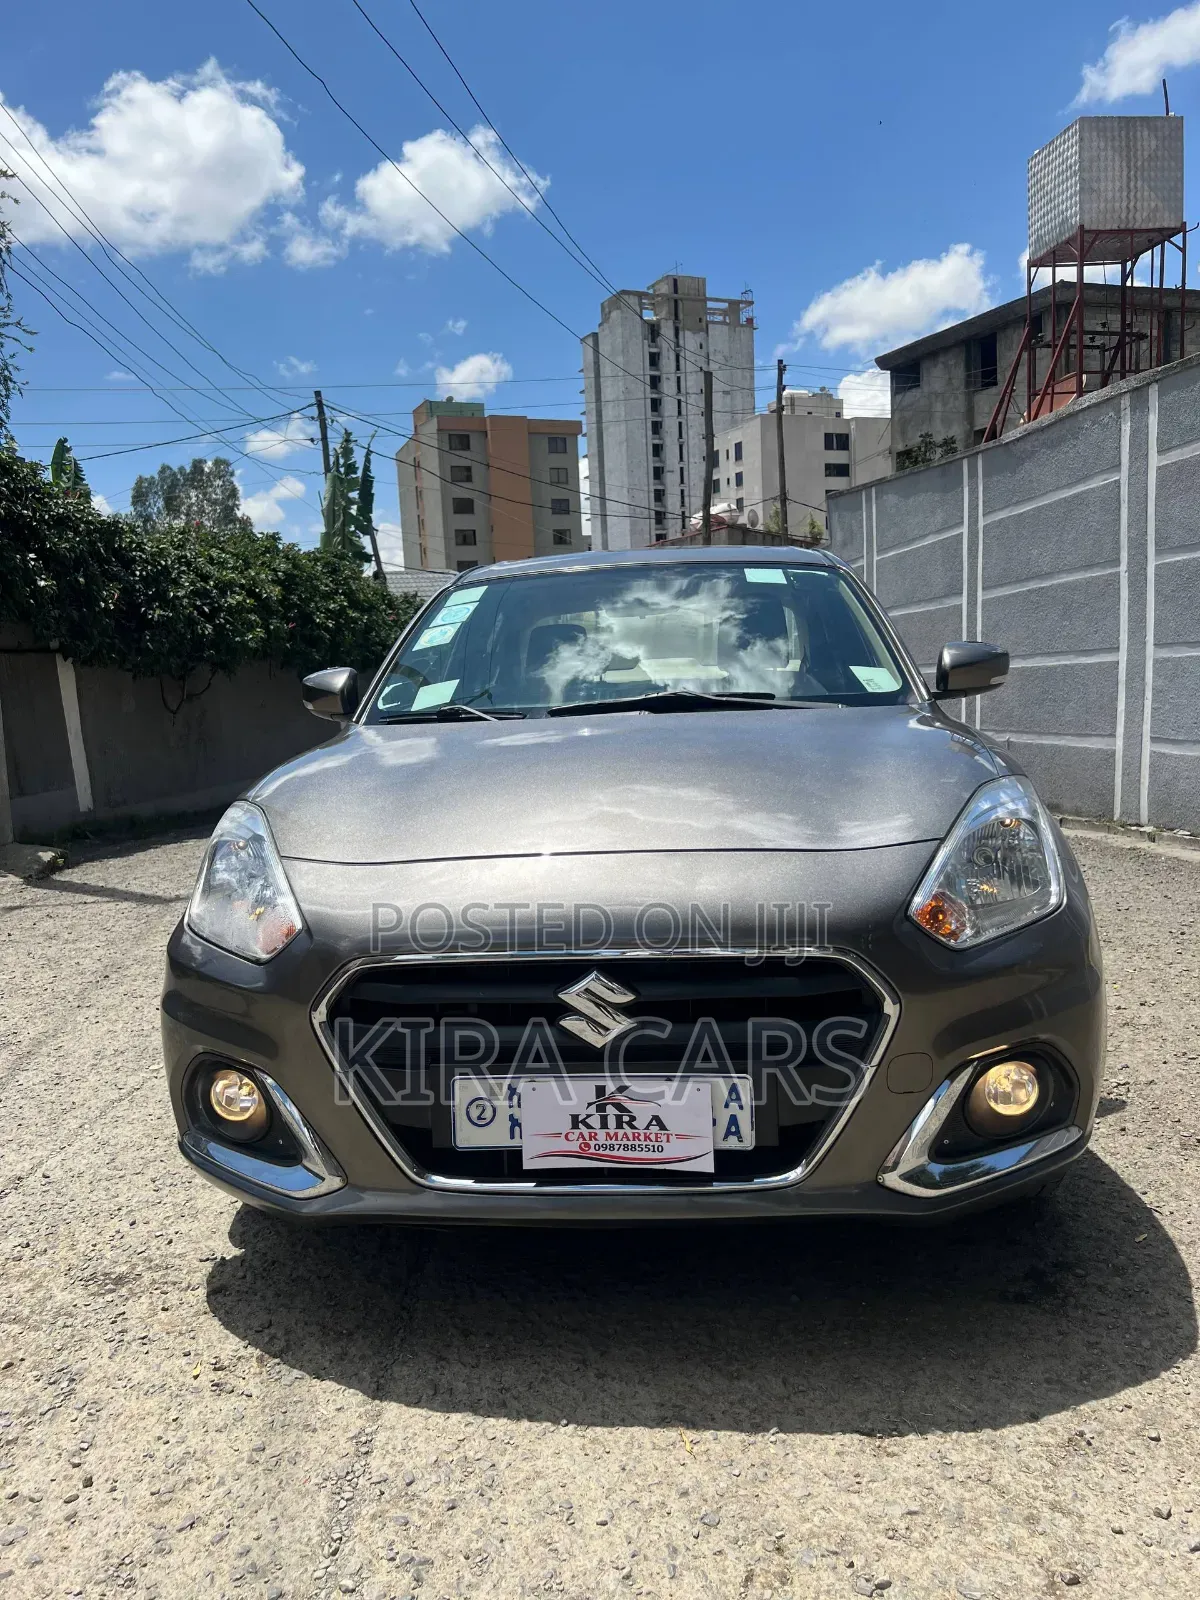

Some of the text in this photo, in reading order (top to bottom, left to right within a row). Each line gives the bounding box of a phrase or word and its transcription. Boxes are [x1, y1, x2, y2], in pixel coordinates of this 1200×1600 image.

[723, 1082, 744, 1110] A
[475, 1103, 487, 1121] 2
[568, 1113, 671, 1132] KIRA
[722, 1113, 744, 1142] A
[564, 1131, 674, 1144] CAR MARKET
[593, 1143, 665, 1153] 0987885510
